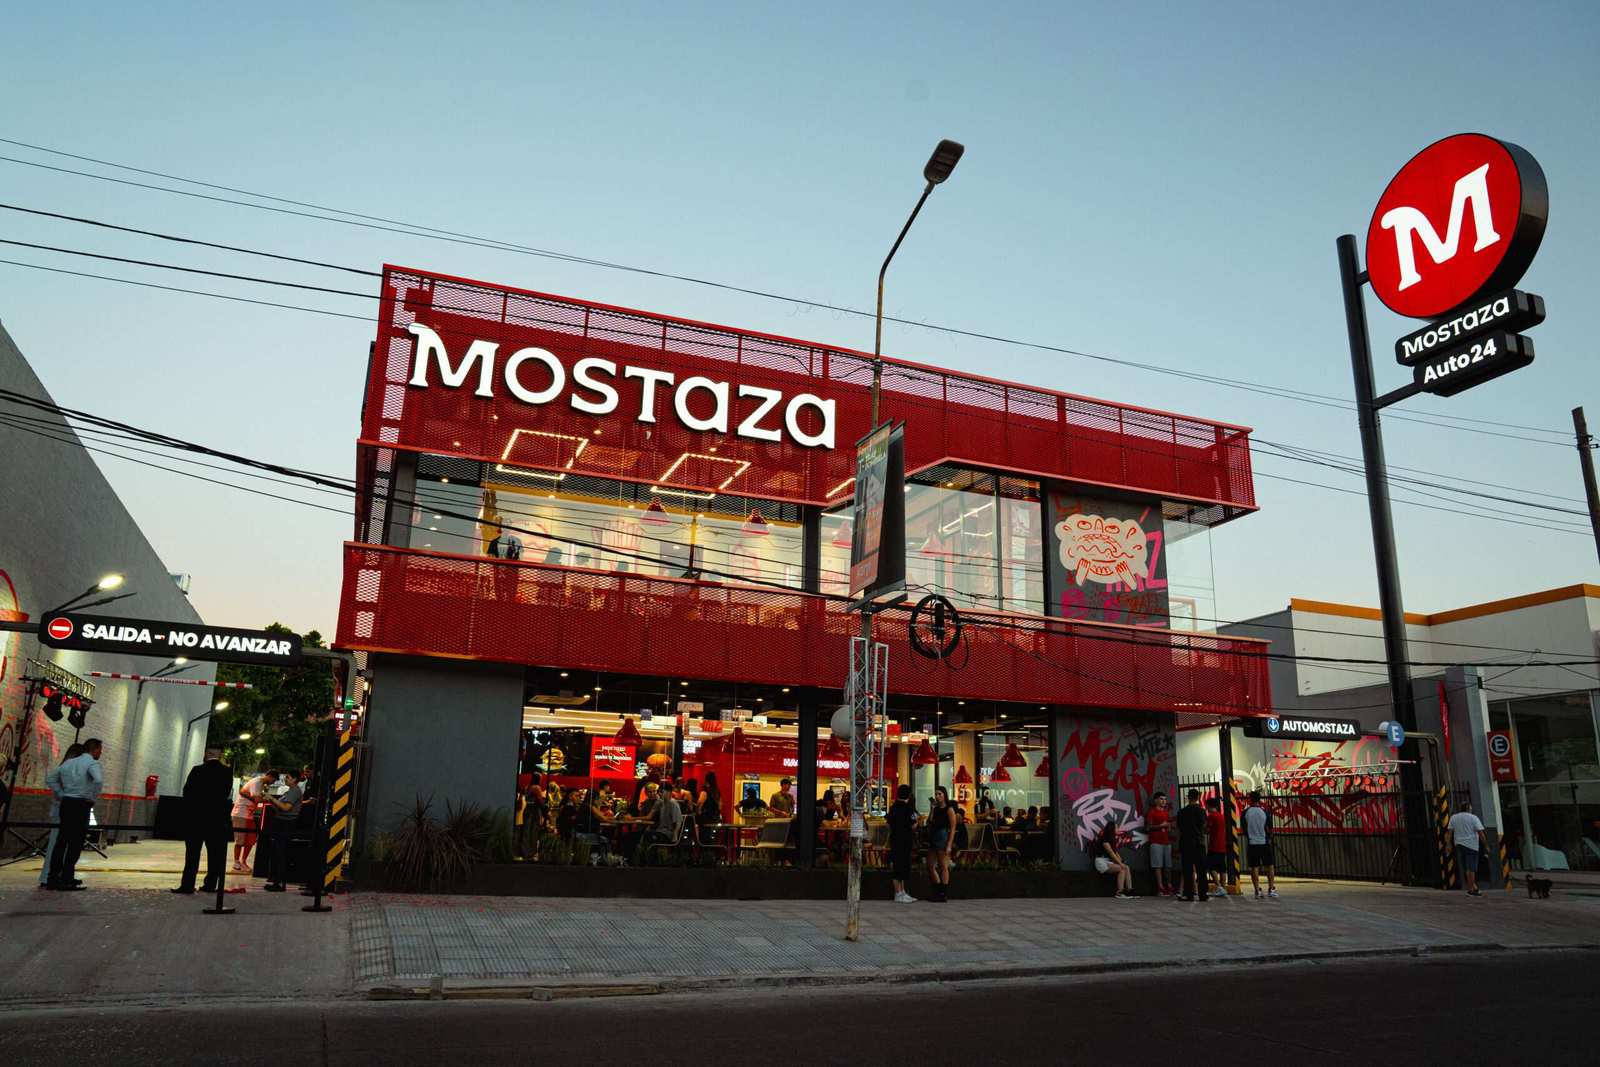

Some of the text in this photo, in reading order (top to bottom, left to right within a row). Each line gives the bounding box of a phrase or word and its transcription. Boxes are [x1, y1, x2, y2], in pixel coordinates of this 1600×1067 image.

[1381, 163, 1500, 291] M
[81, 623, 152, 644] SALIDA
[168, 630, 198, 647] NO
[200, 634, 292, 656] AVANZAR
[1282, 719, 1356, 735] AUTOMOSTAZA
